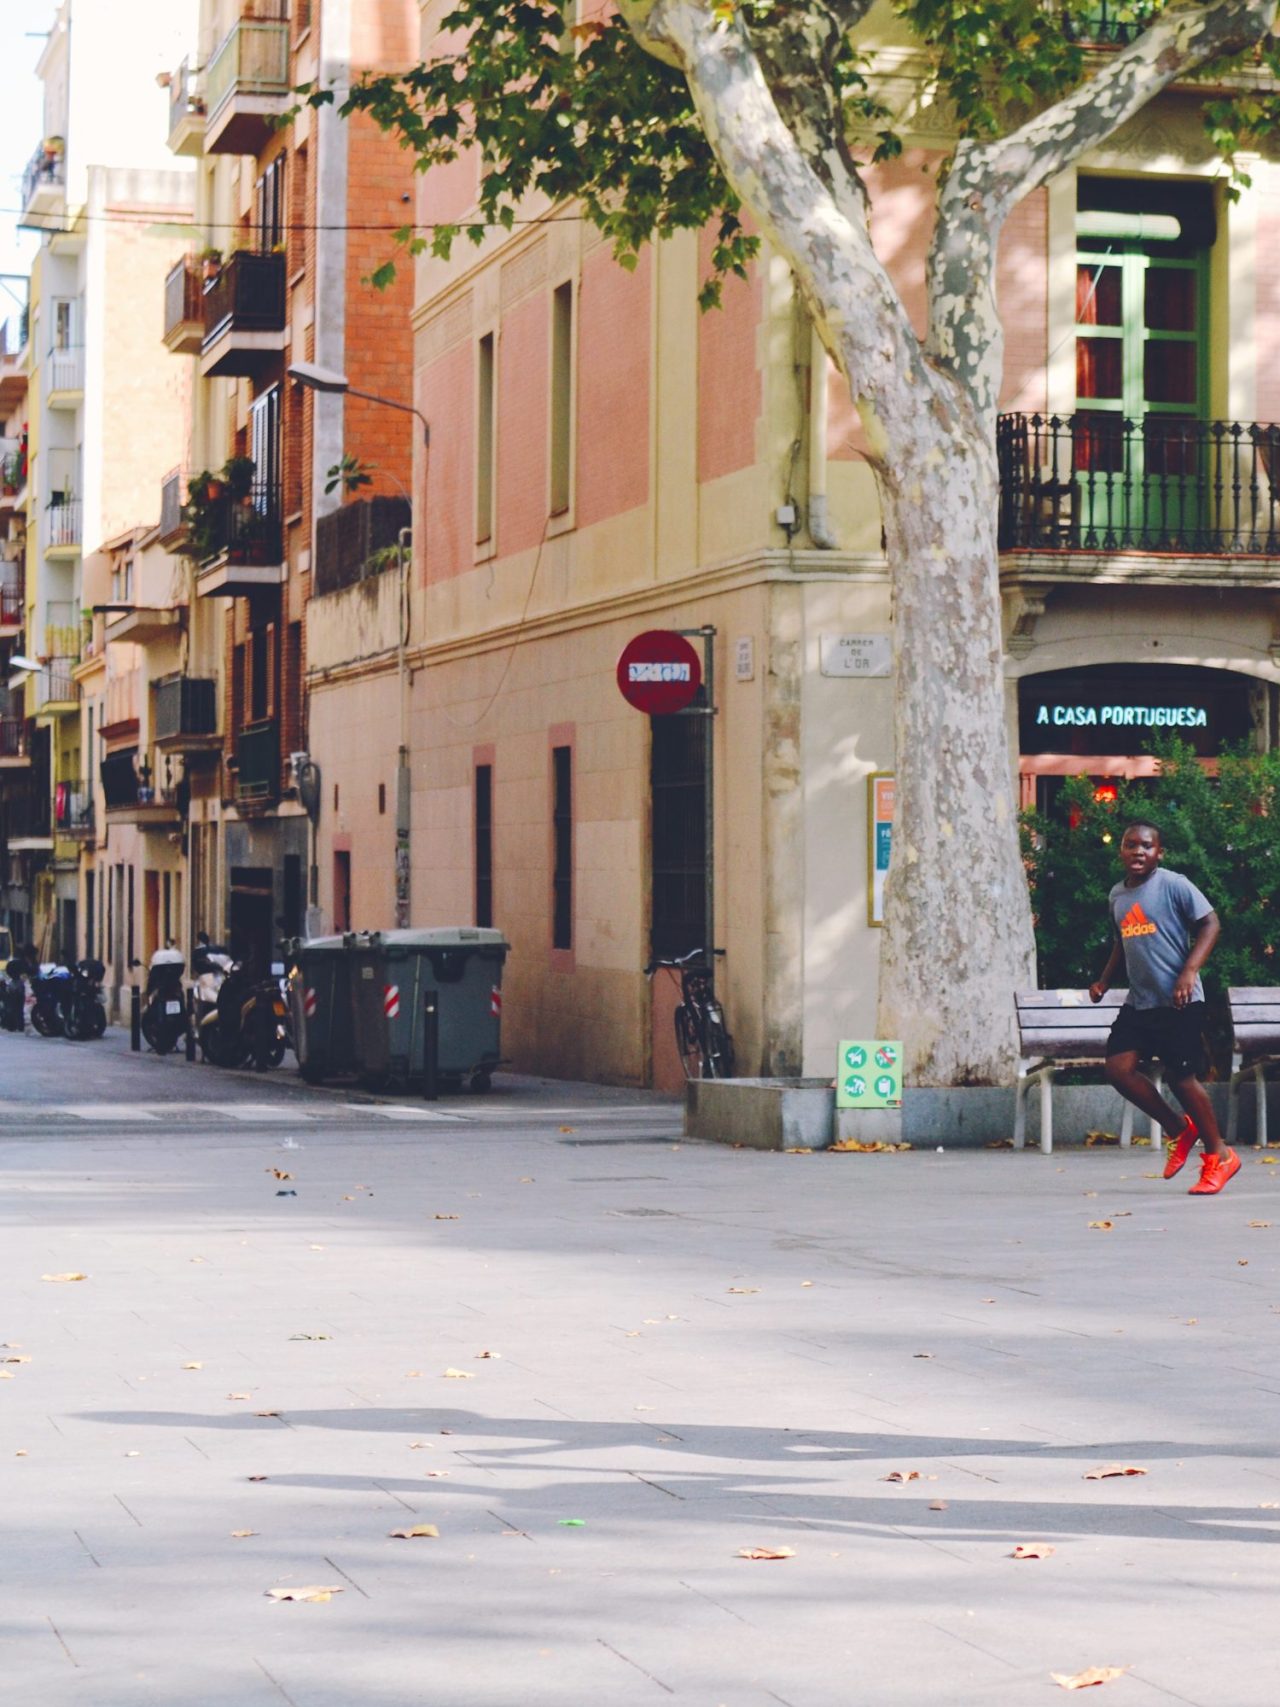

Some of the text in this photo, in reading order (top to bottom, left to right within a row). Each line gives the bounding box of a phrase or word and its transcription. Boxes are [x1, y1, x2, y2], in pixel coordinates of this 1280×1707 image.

[1037, 705, 1207, 727] A CASA PORTUGUESA
